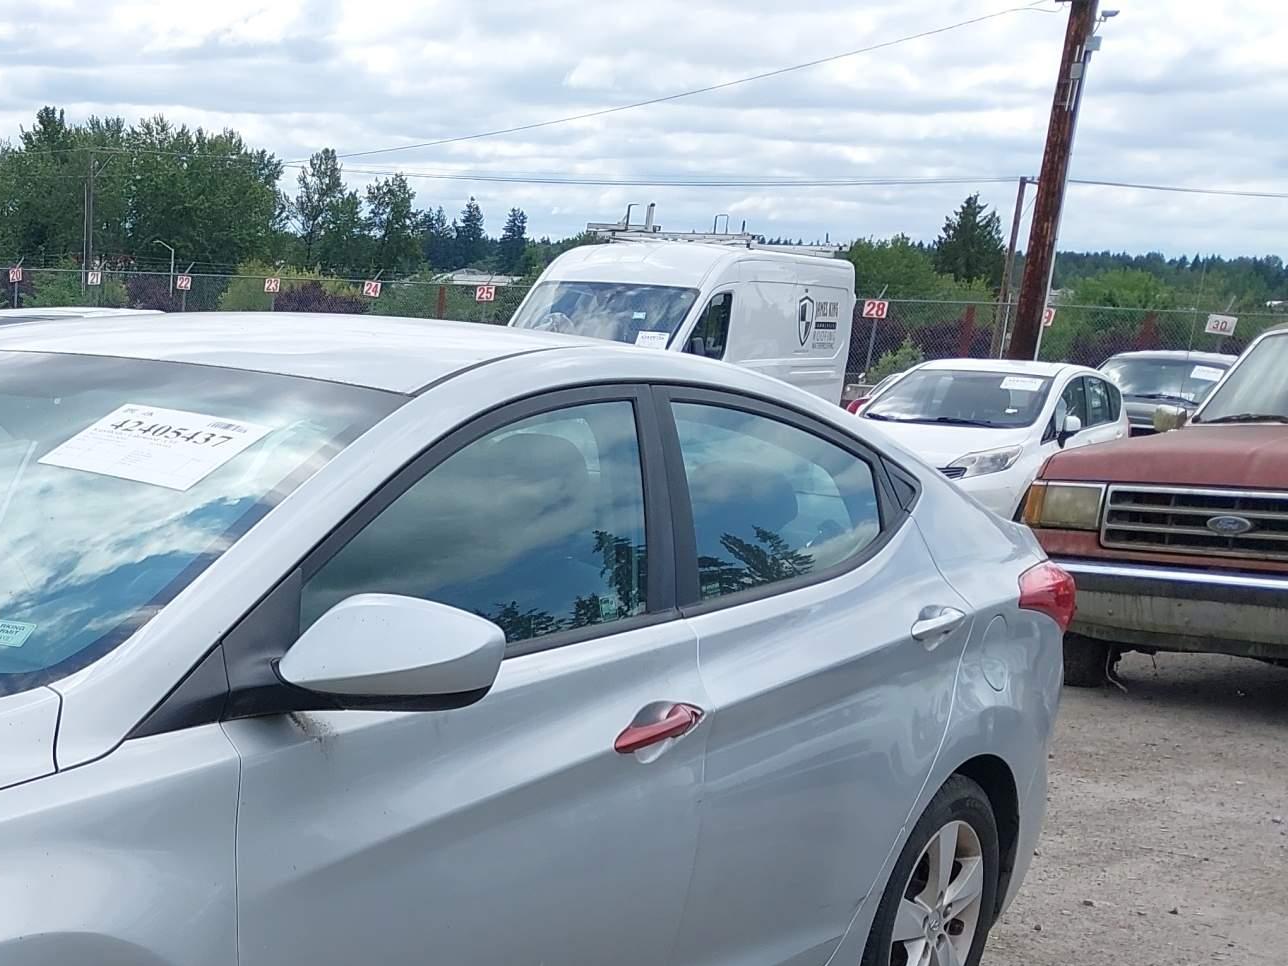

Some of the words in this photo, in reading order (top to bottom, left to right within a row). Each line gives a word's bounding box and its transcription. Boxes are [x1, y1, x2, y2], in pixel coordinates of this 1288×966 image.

[11, 268, 21, 281] 20
[90, 272, 100, 284] 21
[178, 277, 190, 289] 22
[266, 279, 279, 291] 23
[365, 282, 379, 296] 24
[478, 286, 492, 300] 25
[865, 301, 886, 317] 28
[1212, 320, 1228, 331] 30
[110, 419, 233, 448] 42405437
